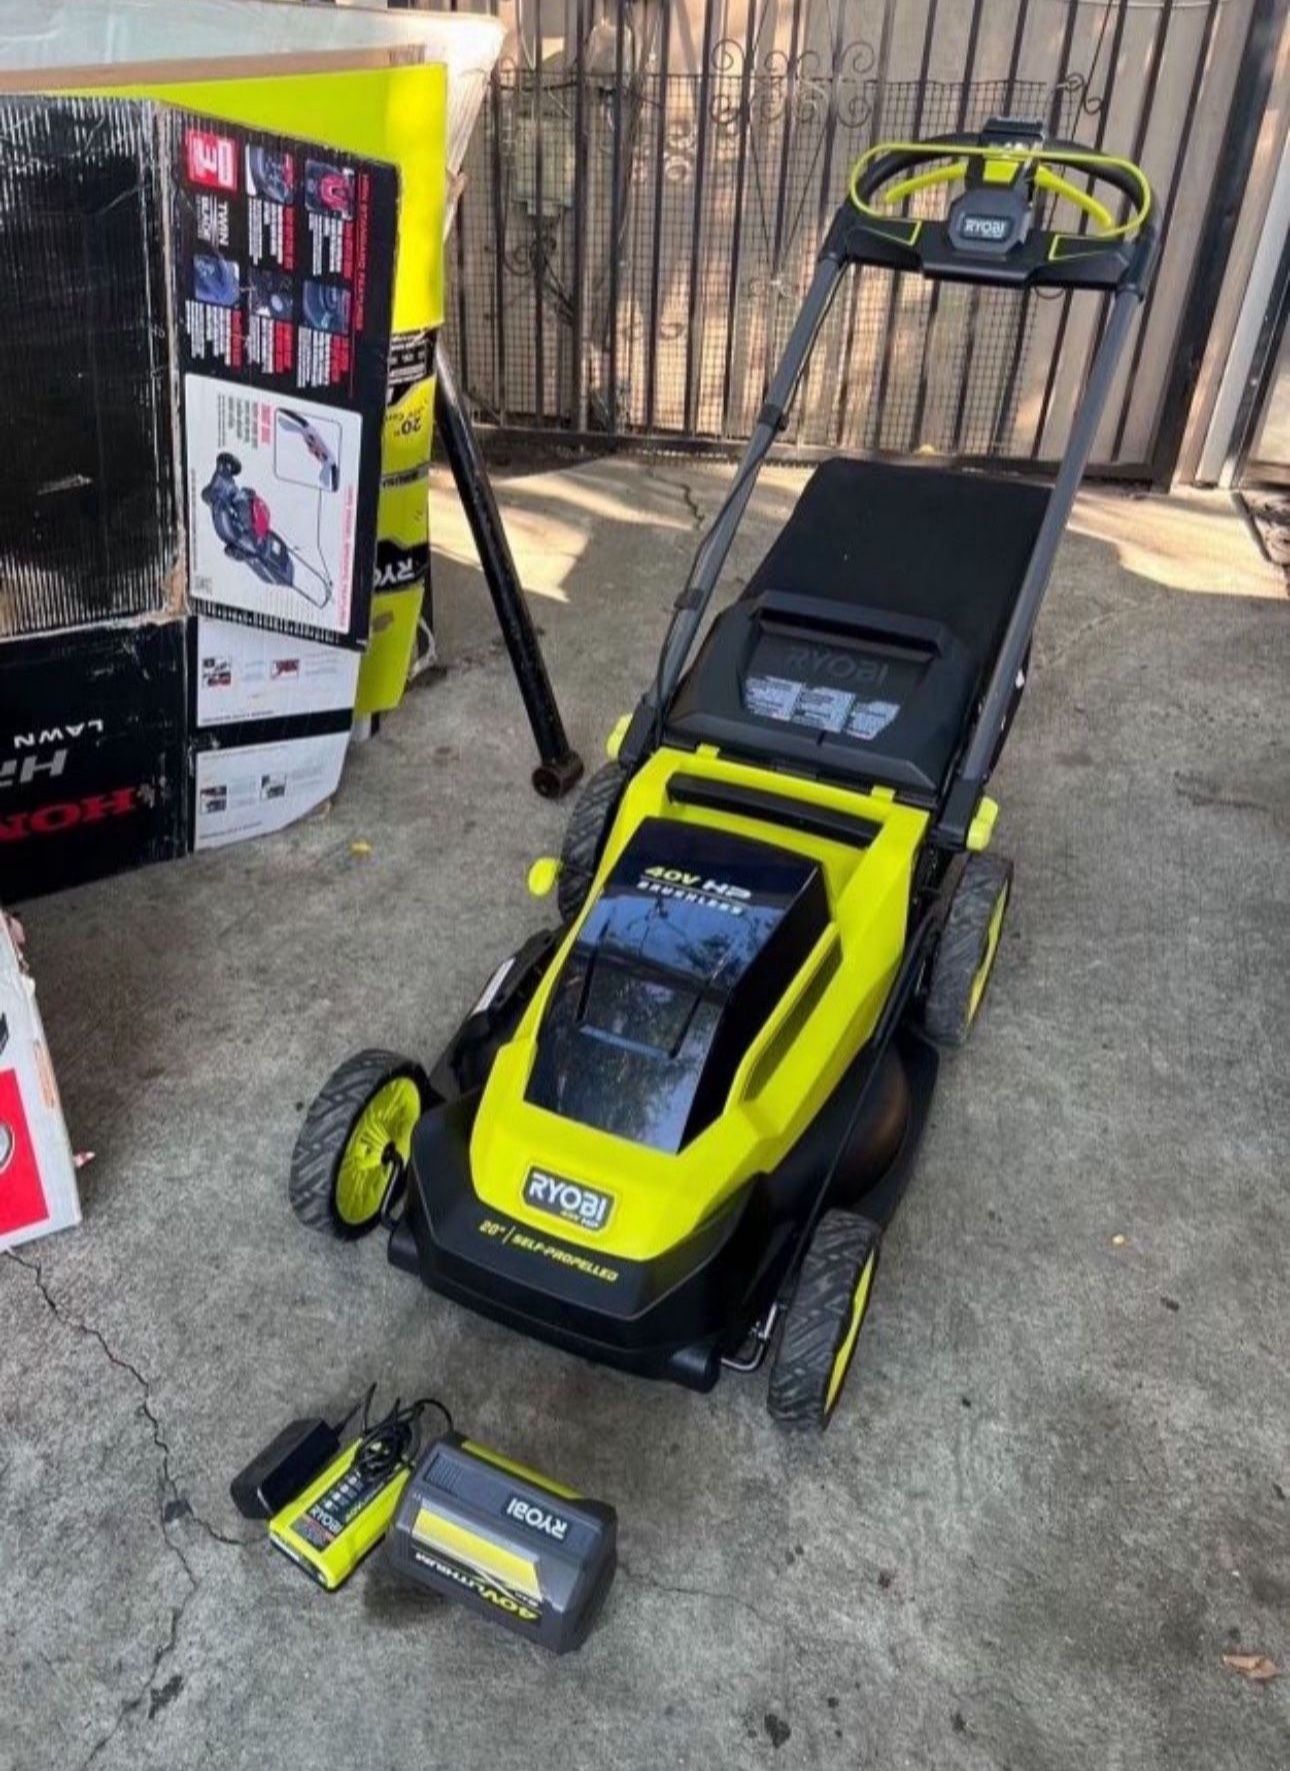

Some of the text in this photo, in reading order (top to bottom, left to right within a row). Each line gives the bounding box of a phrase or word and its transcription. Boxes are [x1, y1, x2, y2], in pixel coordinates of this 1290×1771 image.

[218, 200, 229, 246] TWIN
[963, 217, 1006, 236] RYOBI
[787, 646, 890, 686] RYOBI
[13, 719, 104, 749] LAWN
[636, 881, 745, 916] BRUSHLESS
[643, 864, 753, 899] 40V HP
[528, 1171, 609, 1223] RYOBI
[512, 1233, 620, 1283] SELF-PROPELLED
[505, 1497, 569, 1541] RYOBI
[482, 1586, 540, 1621] 40V
